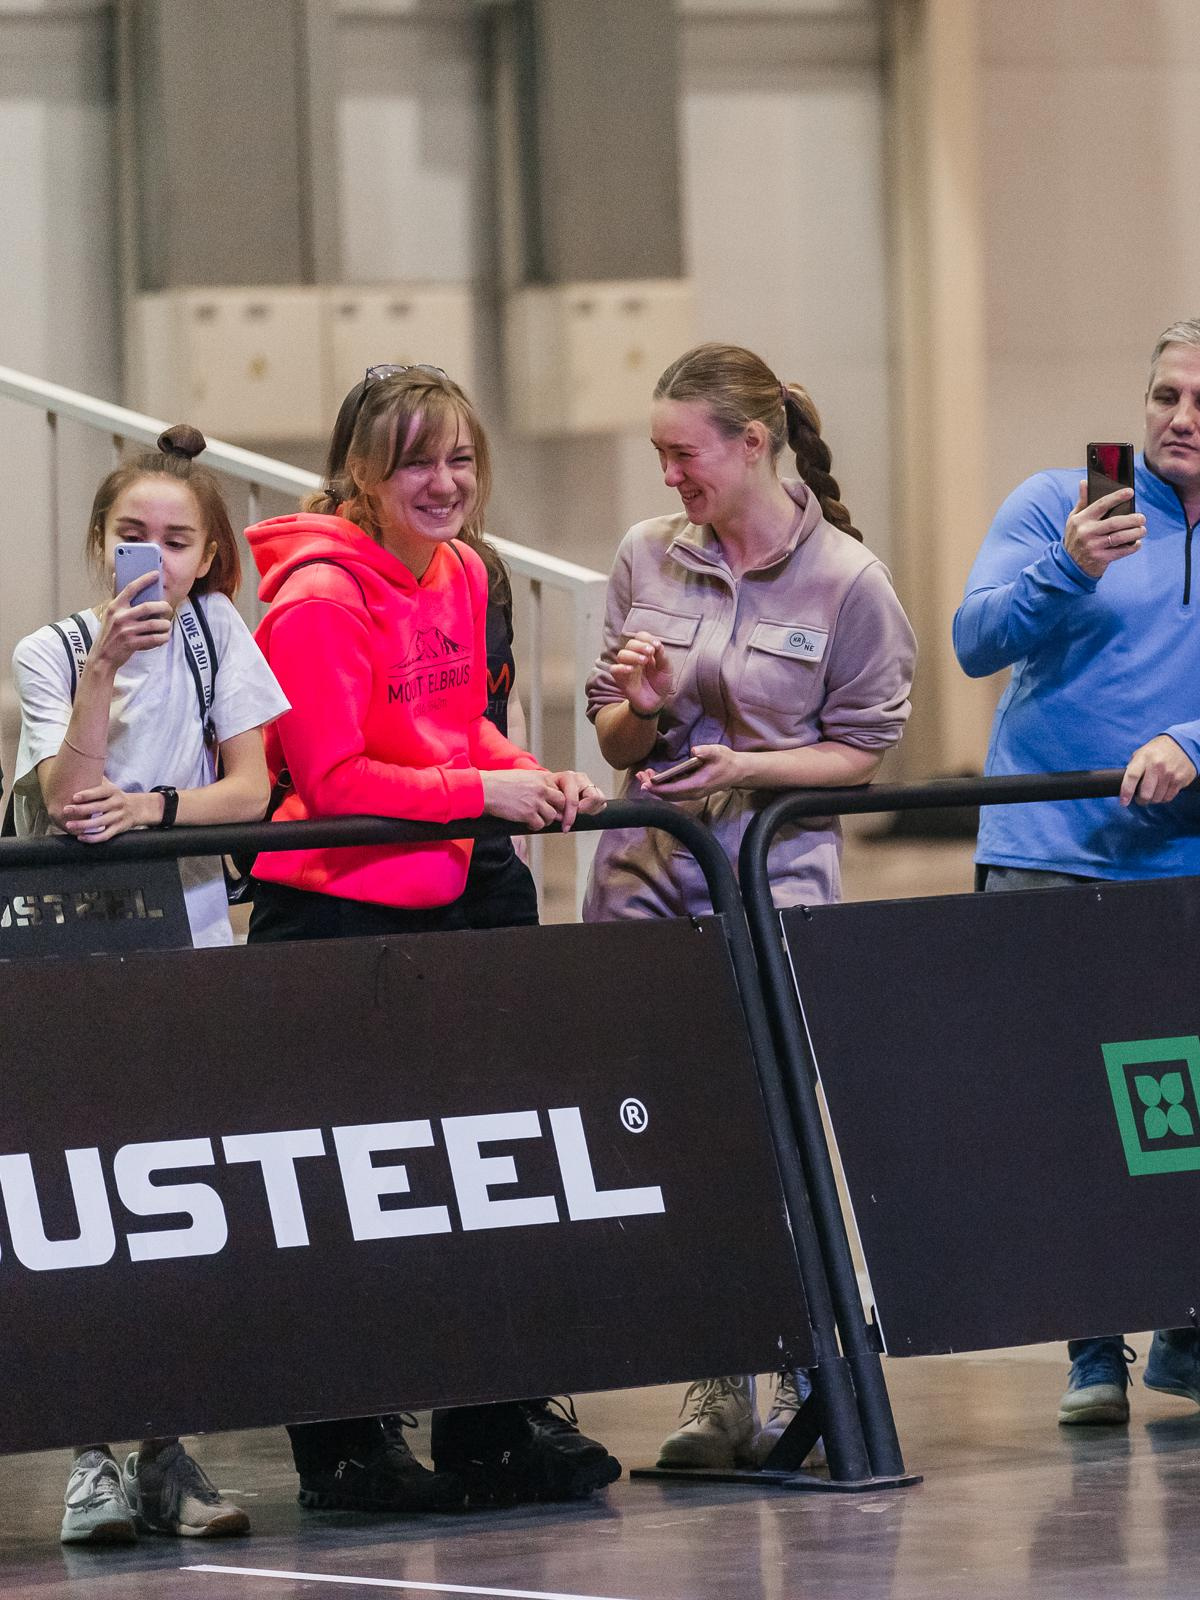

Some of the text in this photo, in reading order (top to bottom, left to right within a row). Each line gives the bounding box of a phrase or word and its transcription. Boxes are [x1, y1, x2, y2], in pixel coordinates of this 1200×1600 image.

[180, 611, 200, 640] LOVE
[68, 631, 85, 655] LOVE
[428, 664, 471, 694] ELBRUS
[0, 1106, 666, 1271] USTEEL
